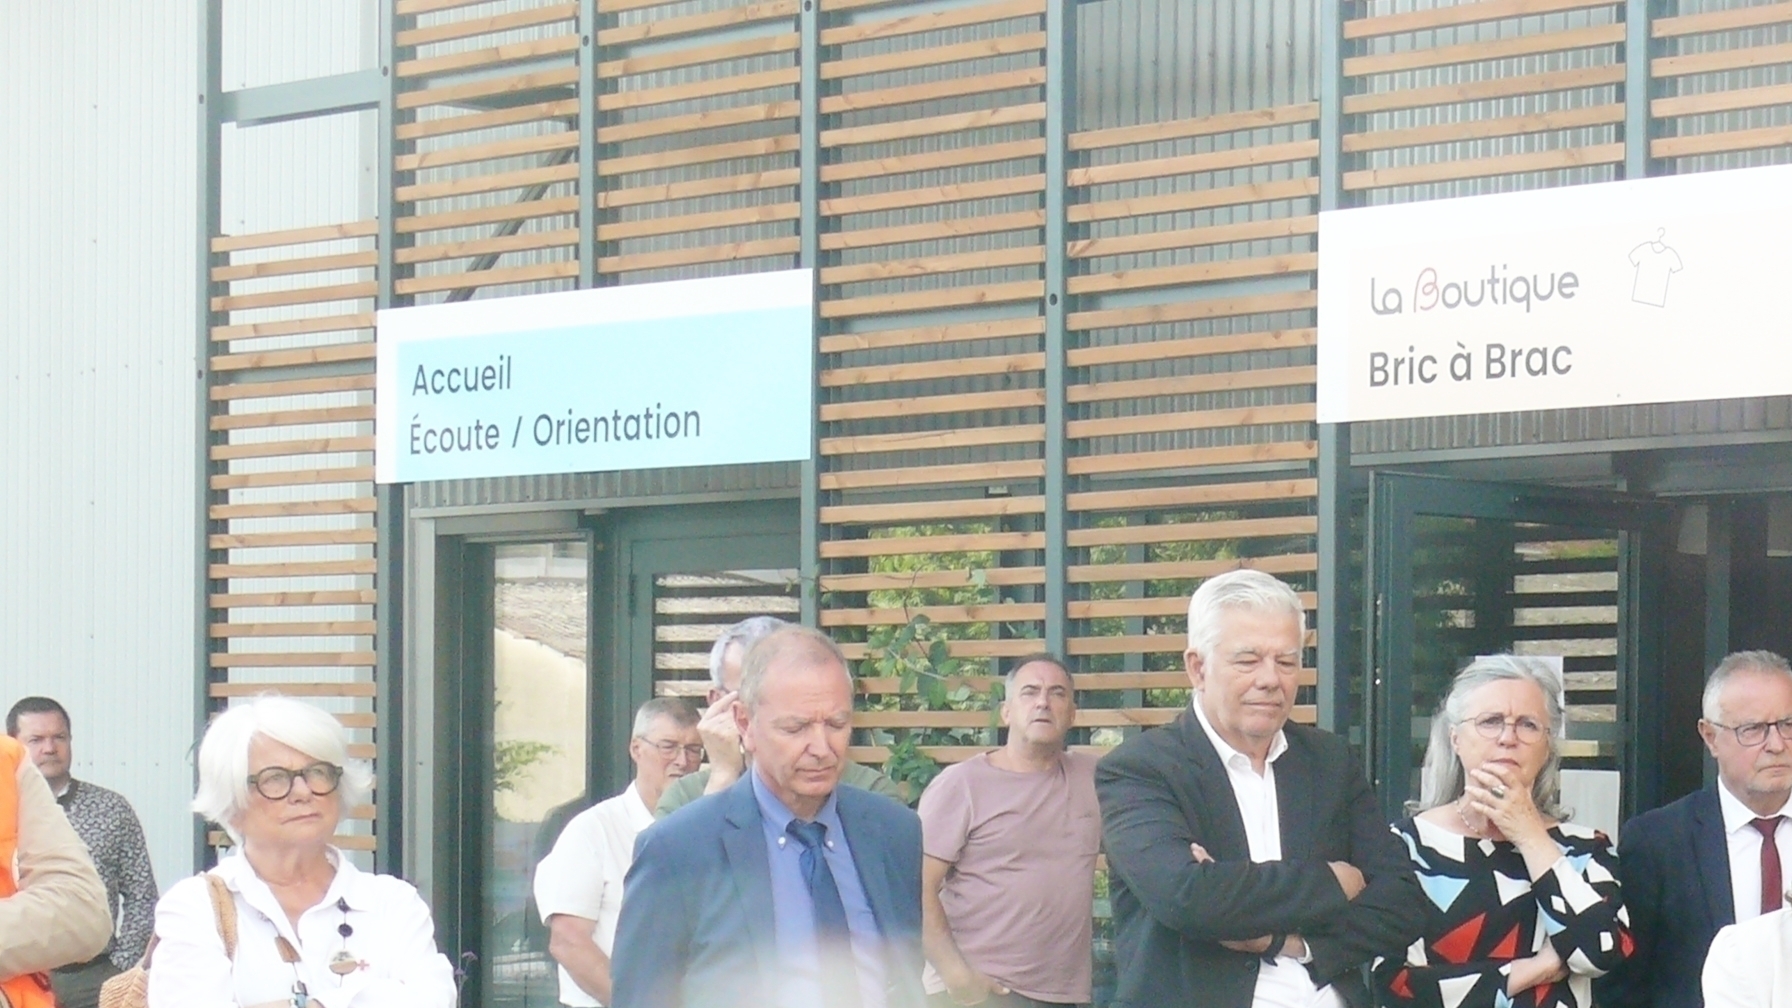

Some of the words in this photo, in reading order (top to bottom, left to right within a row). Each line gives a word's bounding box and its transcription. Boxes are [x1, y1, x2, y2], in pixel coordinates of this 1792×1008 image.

[1413, 263, 1579, 313] Boutique
[412, 354, 512, 396] Accueil
[1369, 345, 1438, 387] Bric
[1449, 340, 1472, 381] à
[1485, 342, 1573, 379] Brac
[410, 413, 500, 455] Écoute
[512, 415, 523, 448] /
[532, 402, 701, 447] Orientation
